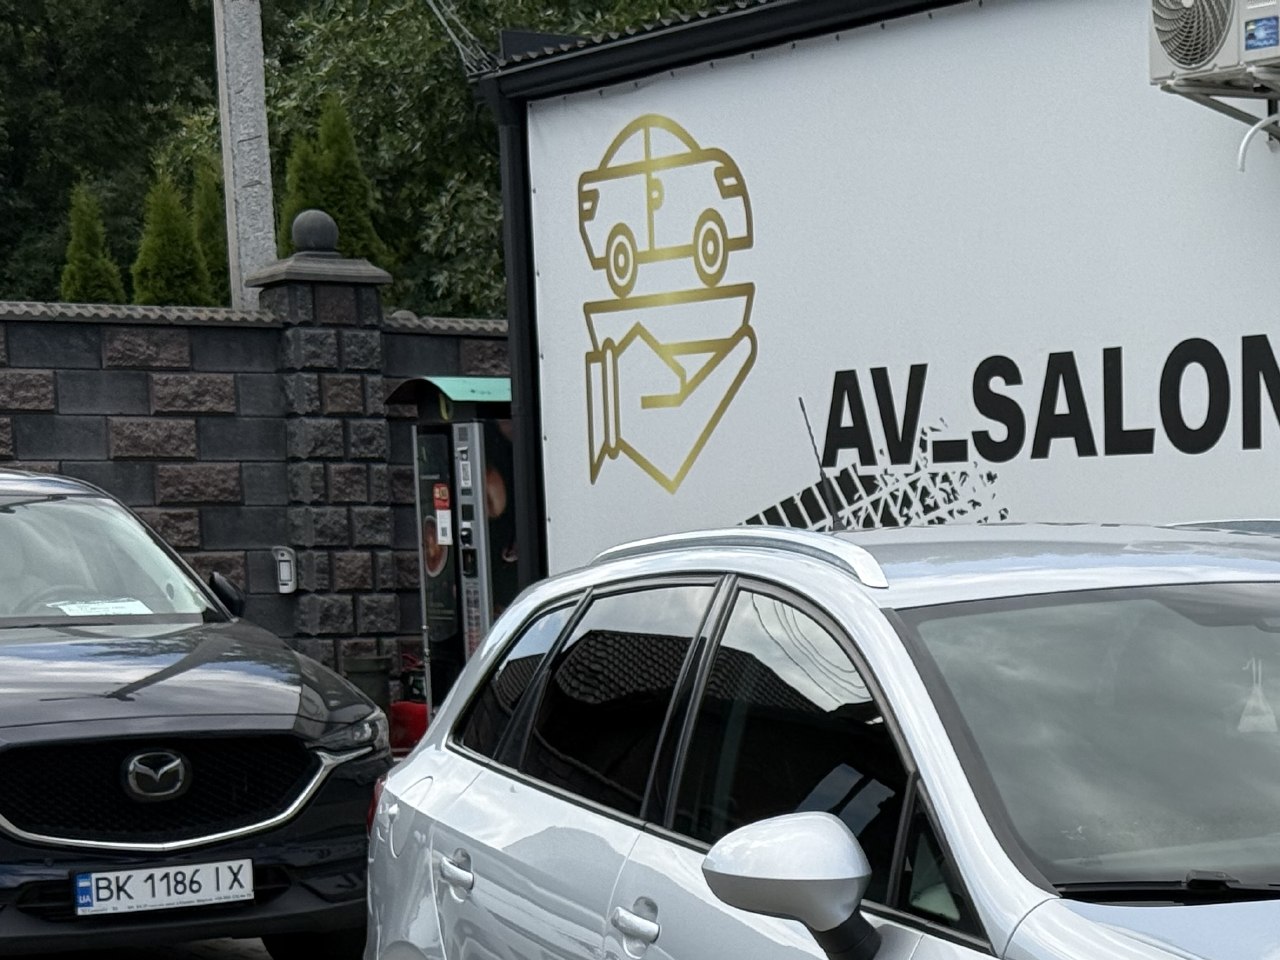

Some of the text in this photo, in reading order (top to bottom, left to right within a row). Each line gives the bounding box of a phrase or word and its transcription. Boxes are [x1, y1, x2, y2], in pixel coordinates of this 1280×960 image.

[95, 864, 245, 902] BK 1186 IX
[79, 895, 92, 904] UA
